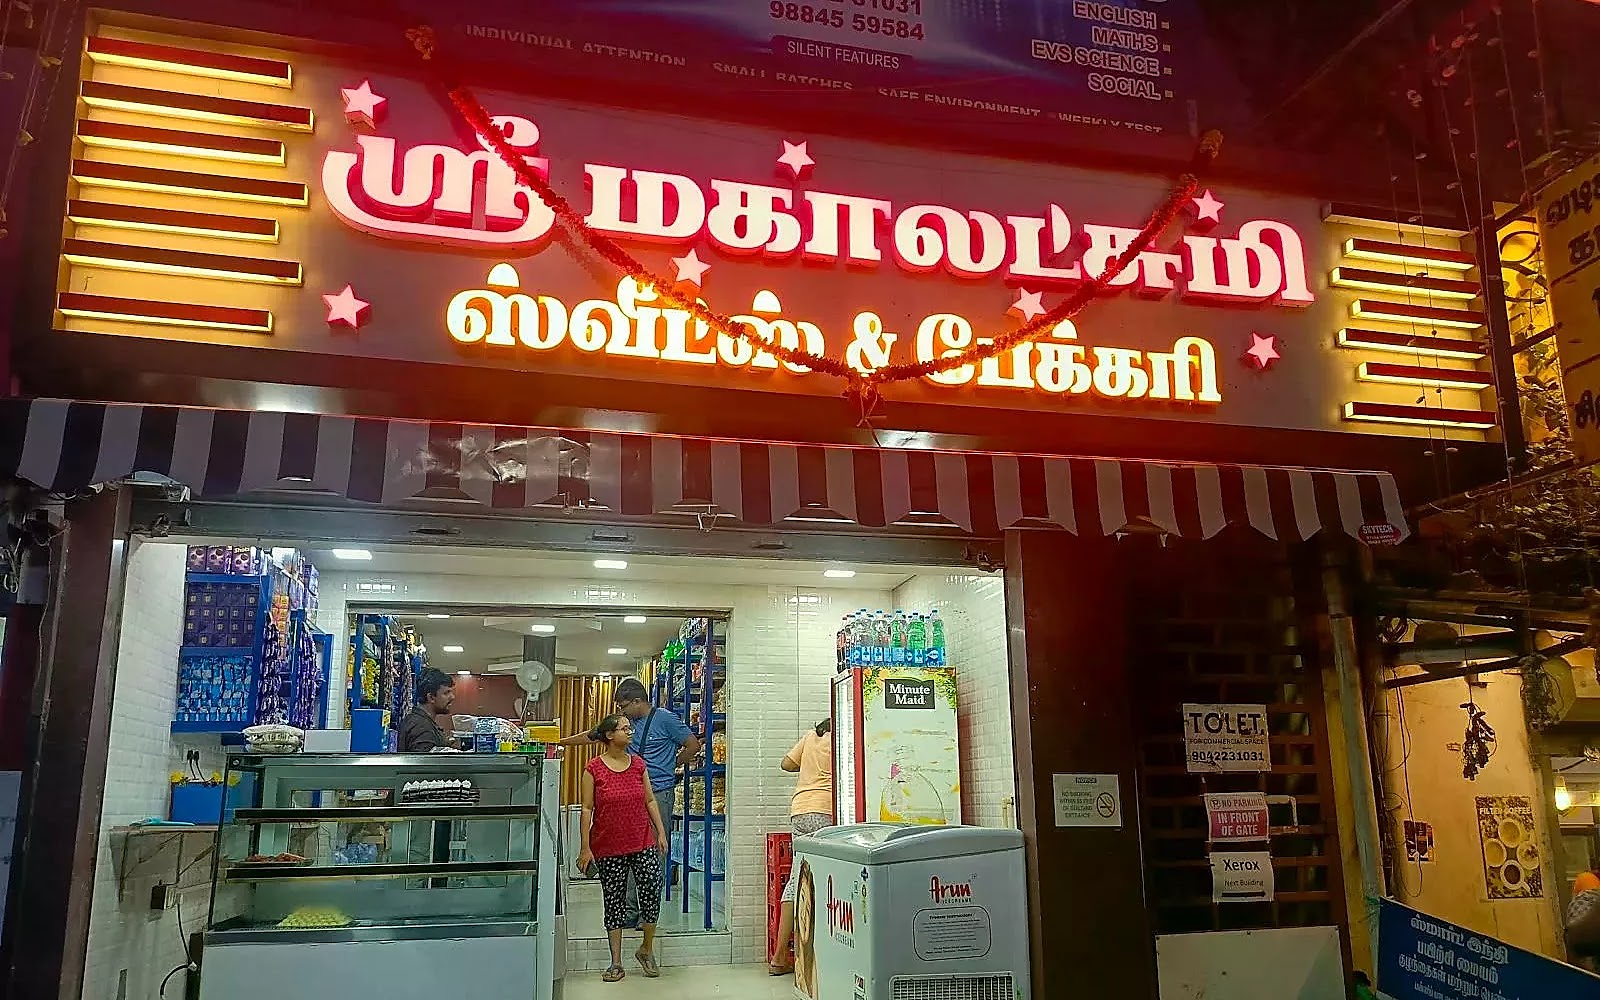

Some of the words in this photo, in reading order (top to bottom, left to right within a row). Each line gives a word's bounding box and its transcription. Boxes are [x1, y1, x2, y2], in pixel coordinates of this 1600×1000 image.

[770, 1, 844, 28] 98845
[852, 14, 924, 40] 59584
[1073, 0, 1157, 30] ENGLISH
[466, 24, 573, 50] INDIVIDUAL
[582, 42, 686, 66] ATTENTION
[1092, 26, 1158, 53] MATHS
[787, 41, 831, 58] SILENT
[835, 48, 900, 69] FEATURES
[1031, 39, 1072, 63] EVS
[1075, 47, 1160, 77] SCIENCE
[1088, 73, 1161, 100] SOCIAL
[583, 162, 1315, 306] மகாலட்சுமி
[845, 311, 898, 377] &
[914, 312, 1222, 402] பேக்கரி
[889, 683, 931, 695] Minute
[895, 693, 925, 706] Maid
[1191, 751, 1265, 761] 9042231031
[1217, 812, 1228, 824] IN
[1230, 811, 1260, 824] FRONT
[1221, 799, 1231, 808] NO
[1221, 825, 1233, 836] OF
[1236, 824, 1258, 836] GATE
[1223, 859, 1260, 872] Xerox
[929, 875, 971, 904] Arun
[827, 874, 854, 937] Arun
[1410, 913, 1465, 947] ஸ்மார்ட்
[1417, 940, 1455, 967] பயிற்சி
[1456, 957, 1499, 985] மையம்
